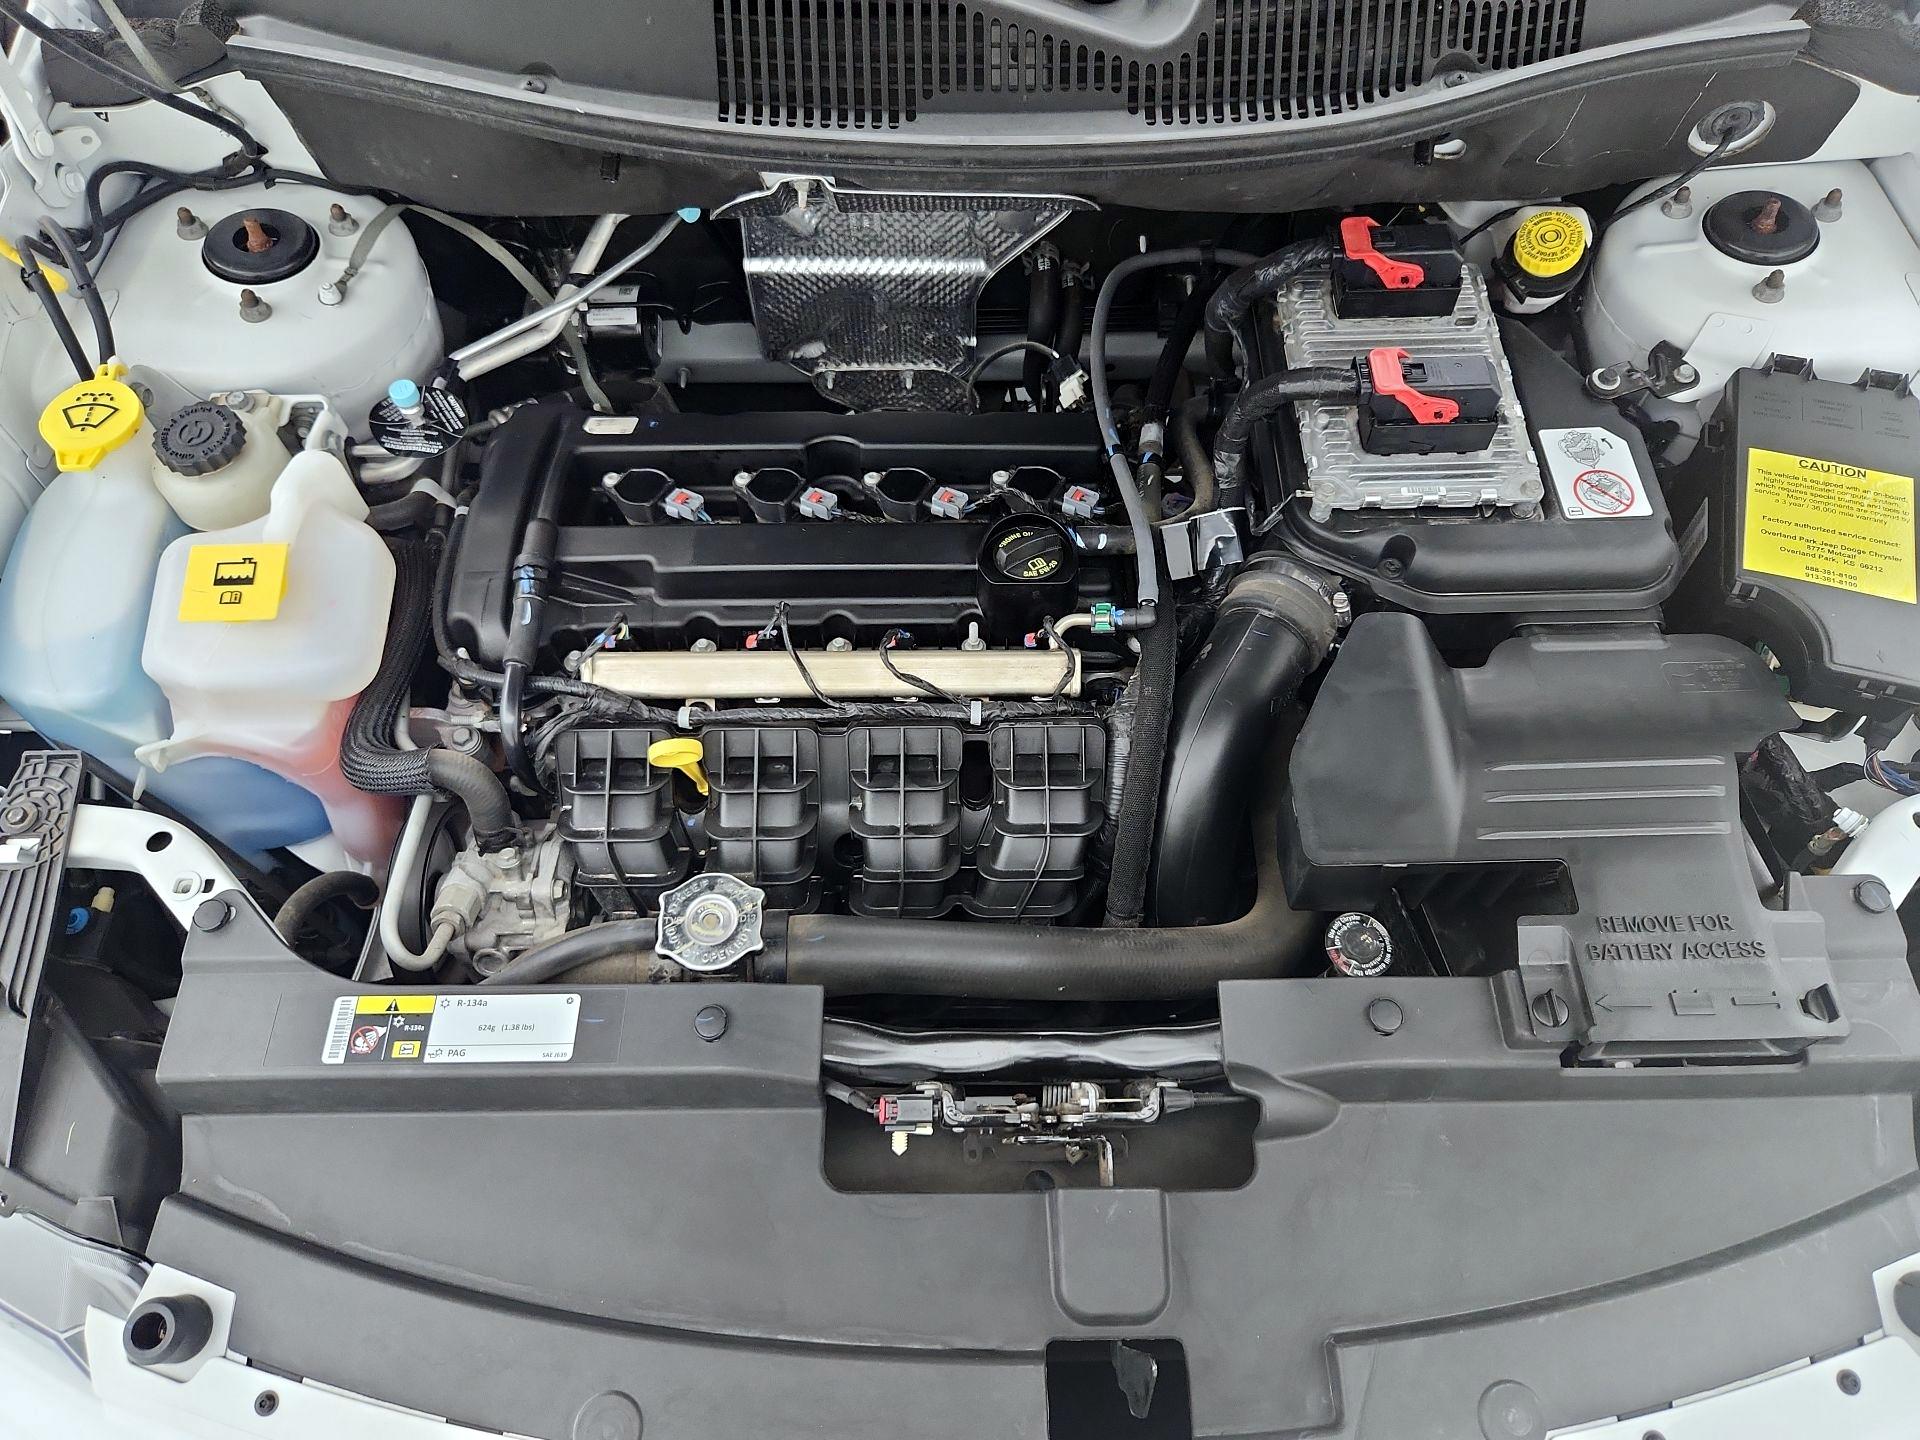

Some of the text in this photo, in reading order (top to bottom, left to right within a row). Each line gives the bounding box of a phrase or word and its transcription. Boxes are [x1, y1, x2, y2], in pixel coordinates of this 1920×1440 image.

[1798, 459, 1867, 478] CAUTION
[1756, 468, 1772, 476] This
[1774, 472, 1800, 481] vehicle
[1810, 479, 1844, 489] equipped
[1763, 476, 1785, 486] highly
[1786, 481, 1835, 494] sophisticated
[1755, 481, 1776, 490] which
[1778, 486, 1808, 496] requires
[1810, 492, 1836, 501] special
[1786, 494, 1808, 502] Many
[1809, 498, 1854, 510] components
[1811, 505, 1837, 514] 36,000
[1762, 515, 1901, 547] Factory authorized service contact:
[1760, 528, 1903, 562] Overland Park Jeep Dodge Chrysler
[1827, 549, 1856, 559] Metcalf
[1039, 560, 1058, 575] 5W-20
[1780, 546, 1816, 558] Overland
[1818, 553, 1839, 564] Park,
[1859, 562, 1883, 573] 66212
[1597, 914, 1735, 933] REMOVE FOR
[1585, 940, 1767, 962] BATTERY ACCESS
[456, 998, 488, 1008] R-134a
[404, 1024, 425, 1032] R-134a
[477, 1023, 535, 1032] 624g (1.38 lbs)
[447, 1049, 466, 1057] PAG
